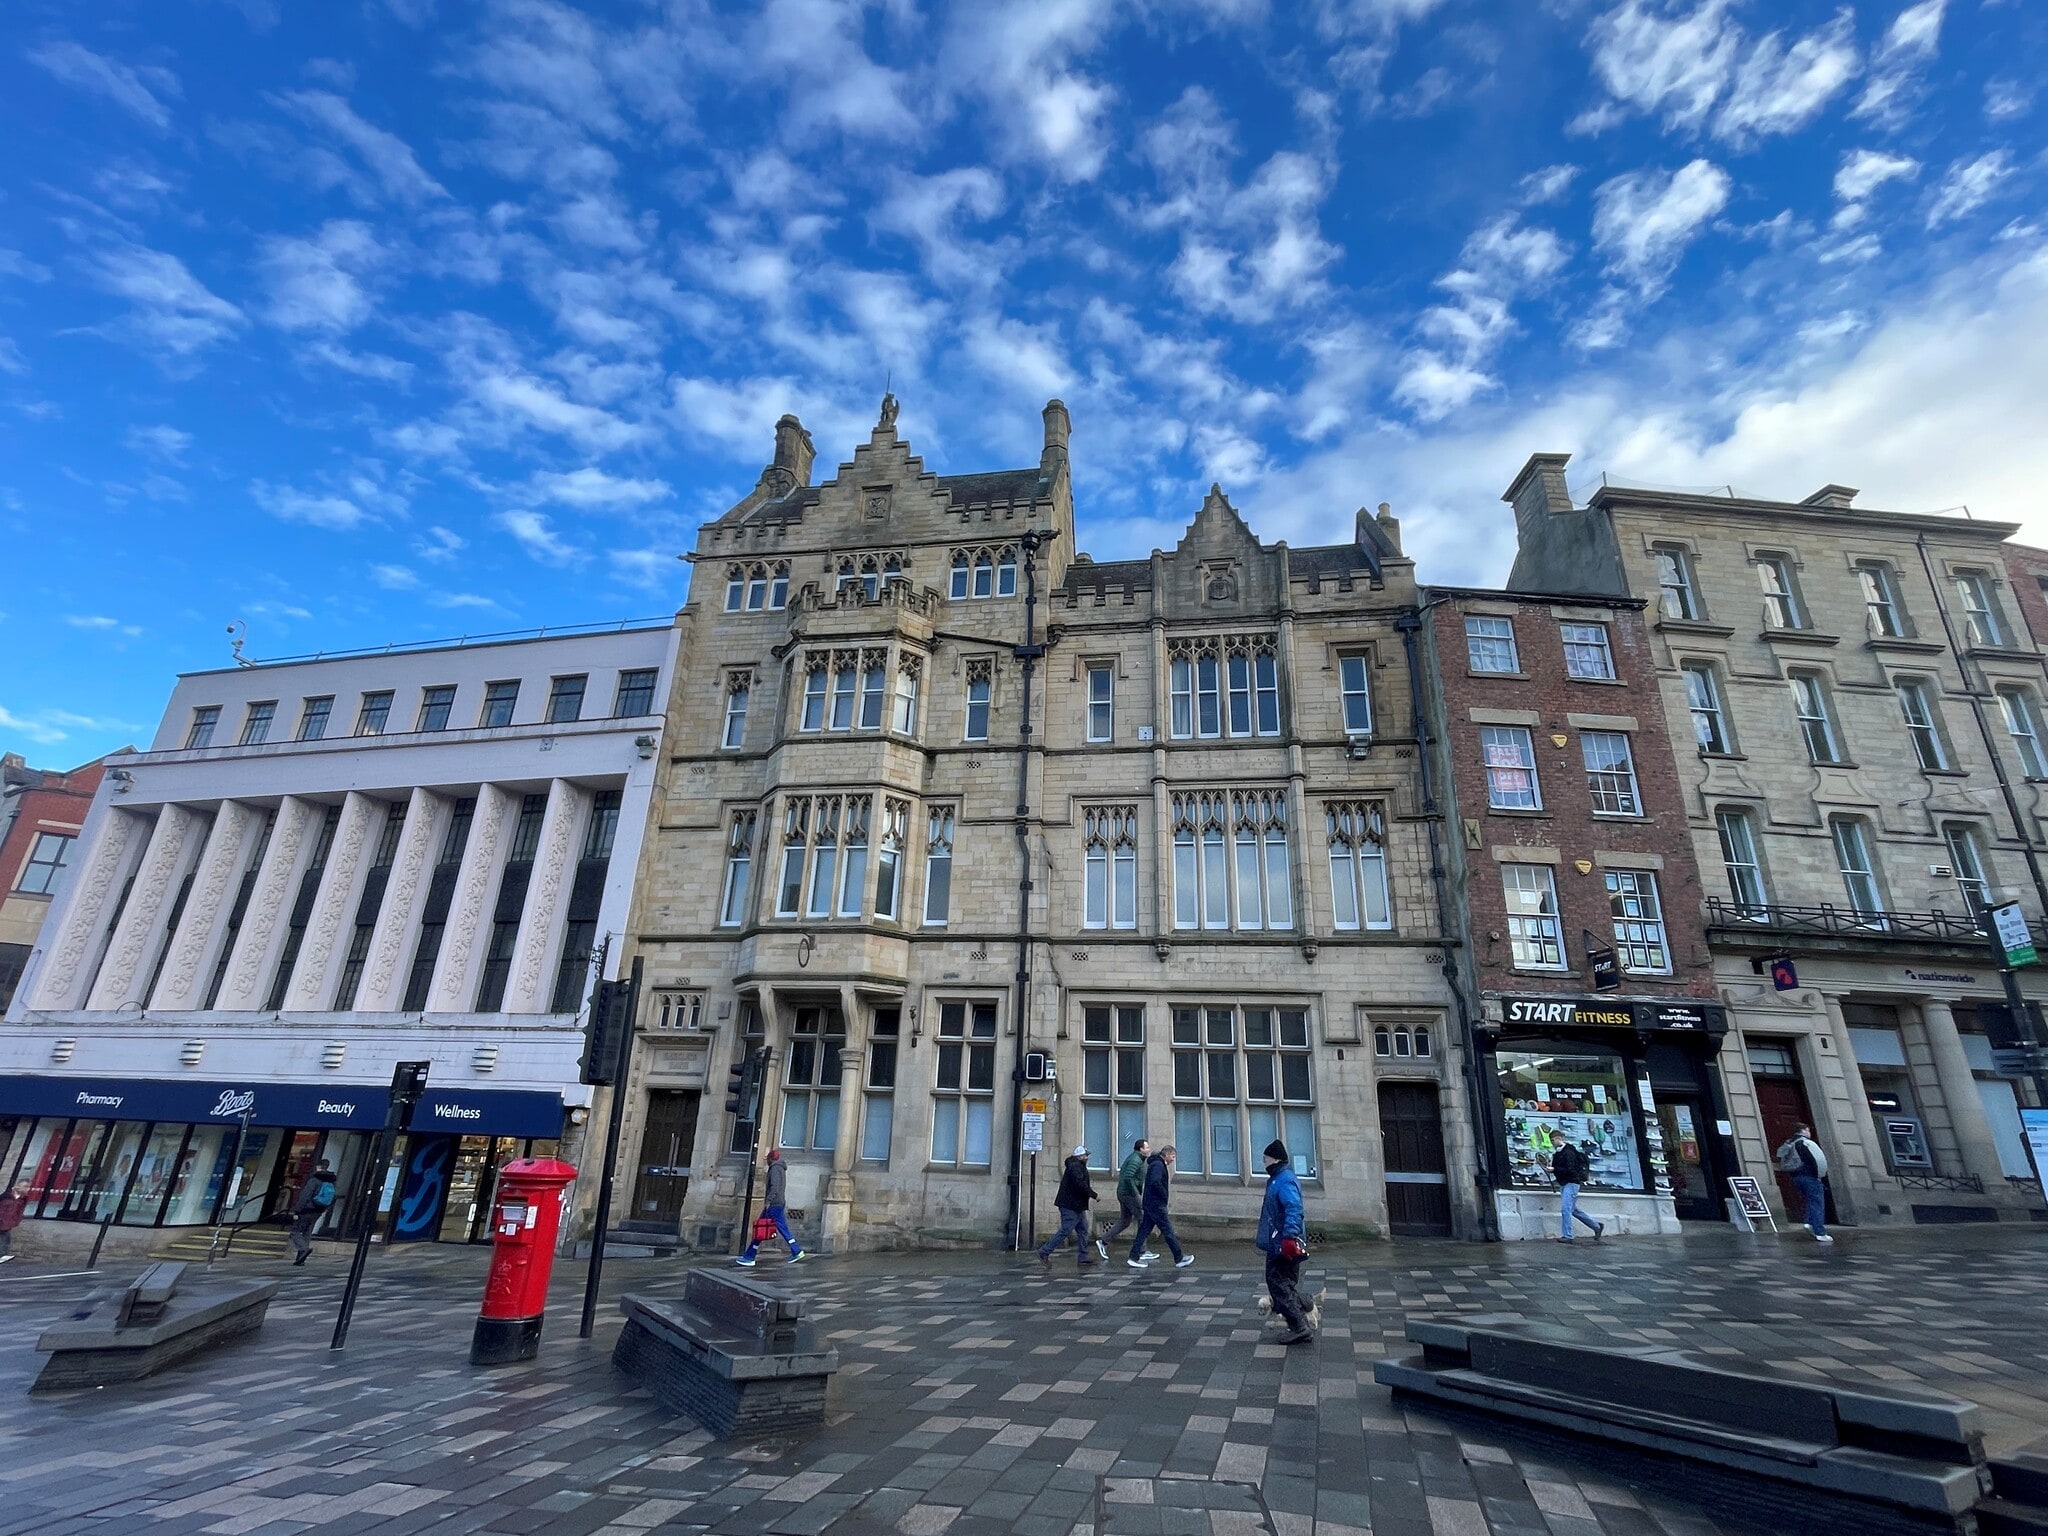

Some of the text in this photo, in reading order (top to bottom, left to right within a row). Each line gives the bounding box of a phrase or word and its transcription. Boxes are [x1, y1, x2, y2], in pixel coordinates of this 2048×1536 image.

[1594, 961, 1612, 973] START
[1918, 971, 1976, 984] nationwide
[1509, 1001, 1631, 1024] START FITNESS
[1659, 1014, 1702, 1022] startfitness
[76, 1091, 124, 1109] Pharmacy
[210, 1089, 254, 1117] Boots
[317, 1099, 356, 1118] Beauty
[434, 1103, 481, 1119] Wellness
